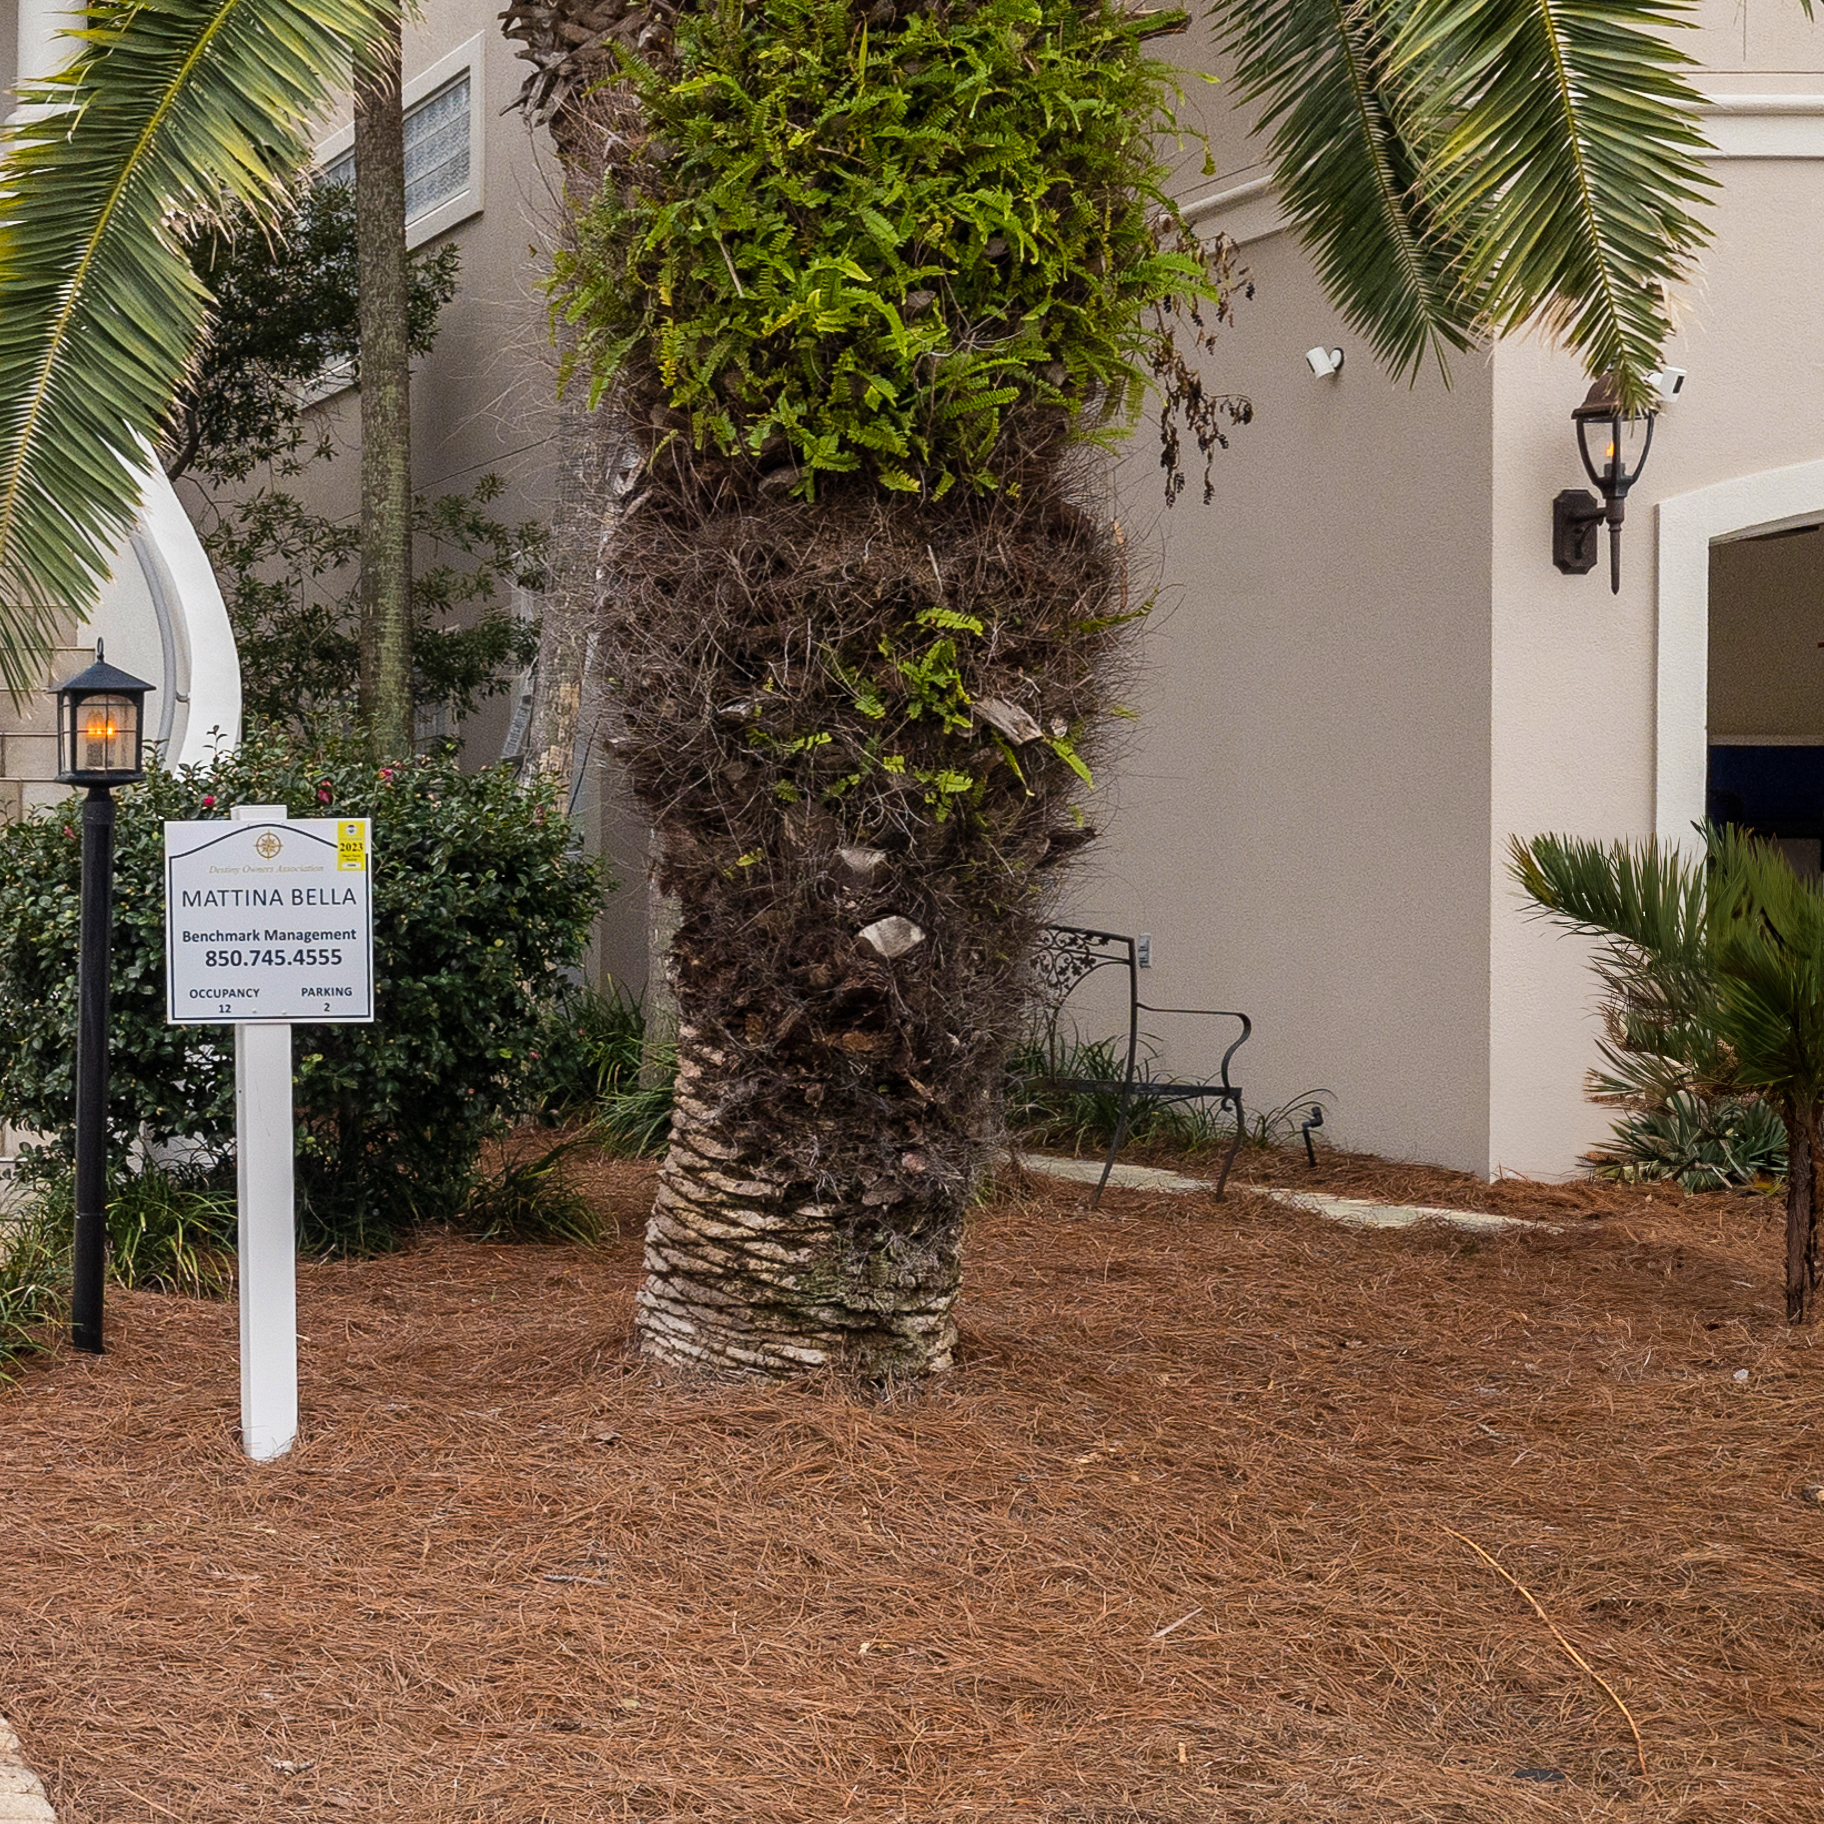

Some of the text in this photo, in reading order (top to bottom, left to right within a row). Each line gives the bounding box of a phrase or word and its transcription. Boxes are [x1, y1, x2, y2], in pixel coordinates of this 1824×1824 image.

[339, 843, 364, 852] 2023
[243, 864, 273, 873] Owners
[276, 864, 324, 873] Association
[182, 888, 357, 907] MATTINA BELLA
[182, 928, 357, 944] Benchmark Management
[205, 949, 342, 967] 850.745.4555
[189, 989, 260, 999] OCCUPANCY
[301, 987, 353, 997] PARKING
[218, 1004, 231, 1013] 12
[323, 1003, 330, 1012] 2
